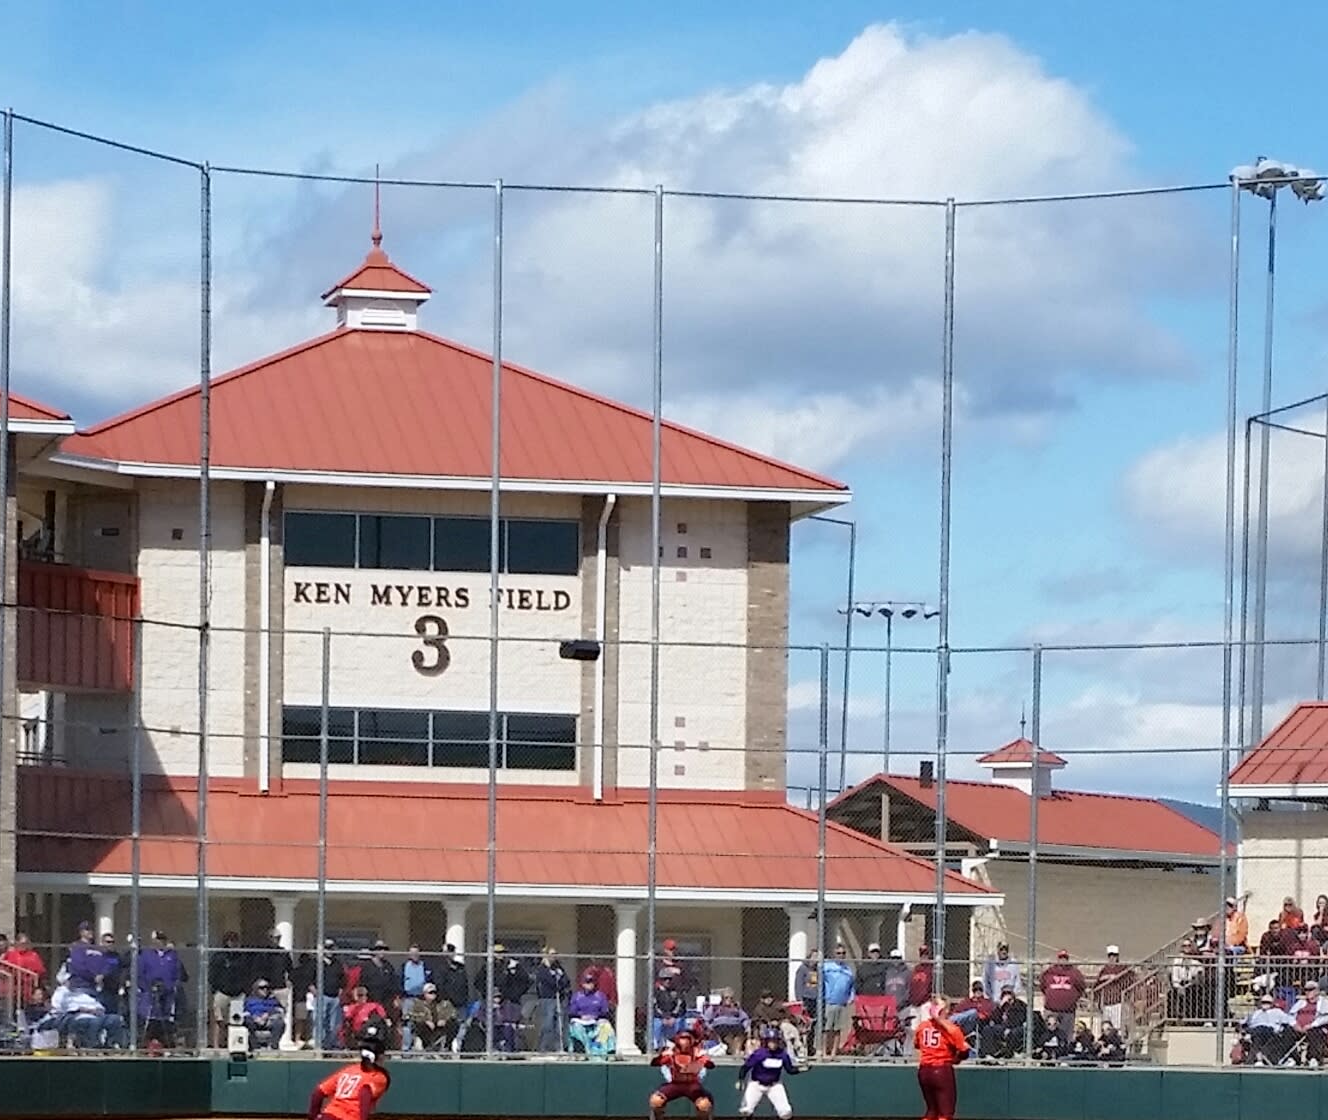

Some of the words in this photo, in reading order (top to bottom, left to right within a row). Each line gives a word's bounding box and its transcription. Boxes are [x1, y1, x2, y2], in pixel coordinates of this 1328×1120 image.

[293, 581, 352, 605] KEN
[371, 584, 470, 608] MYERS
[411, 615, 451, 677] 3
[923, 1029, 942, 1049] 15
